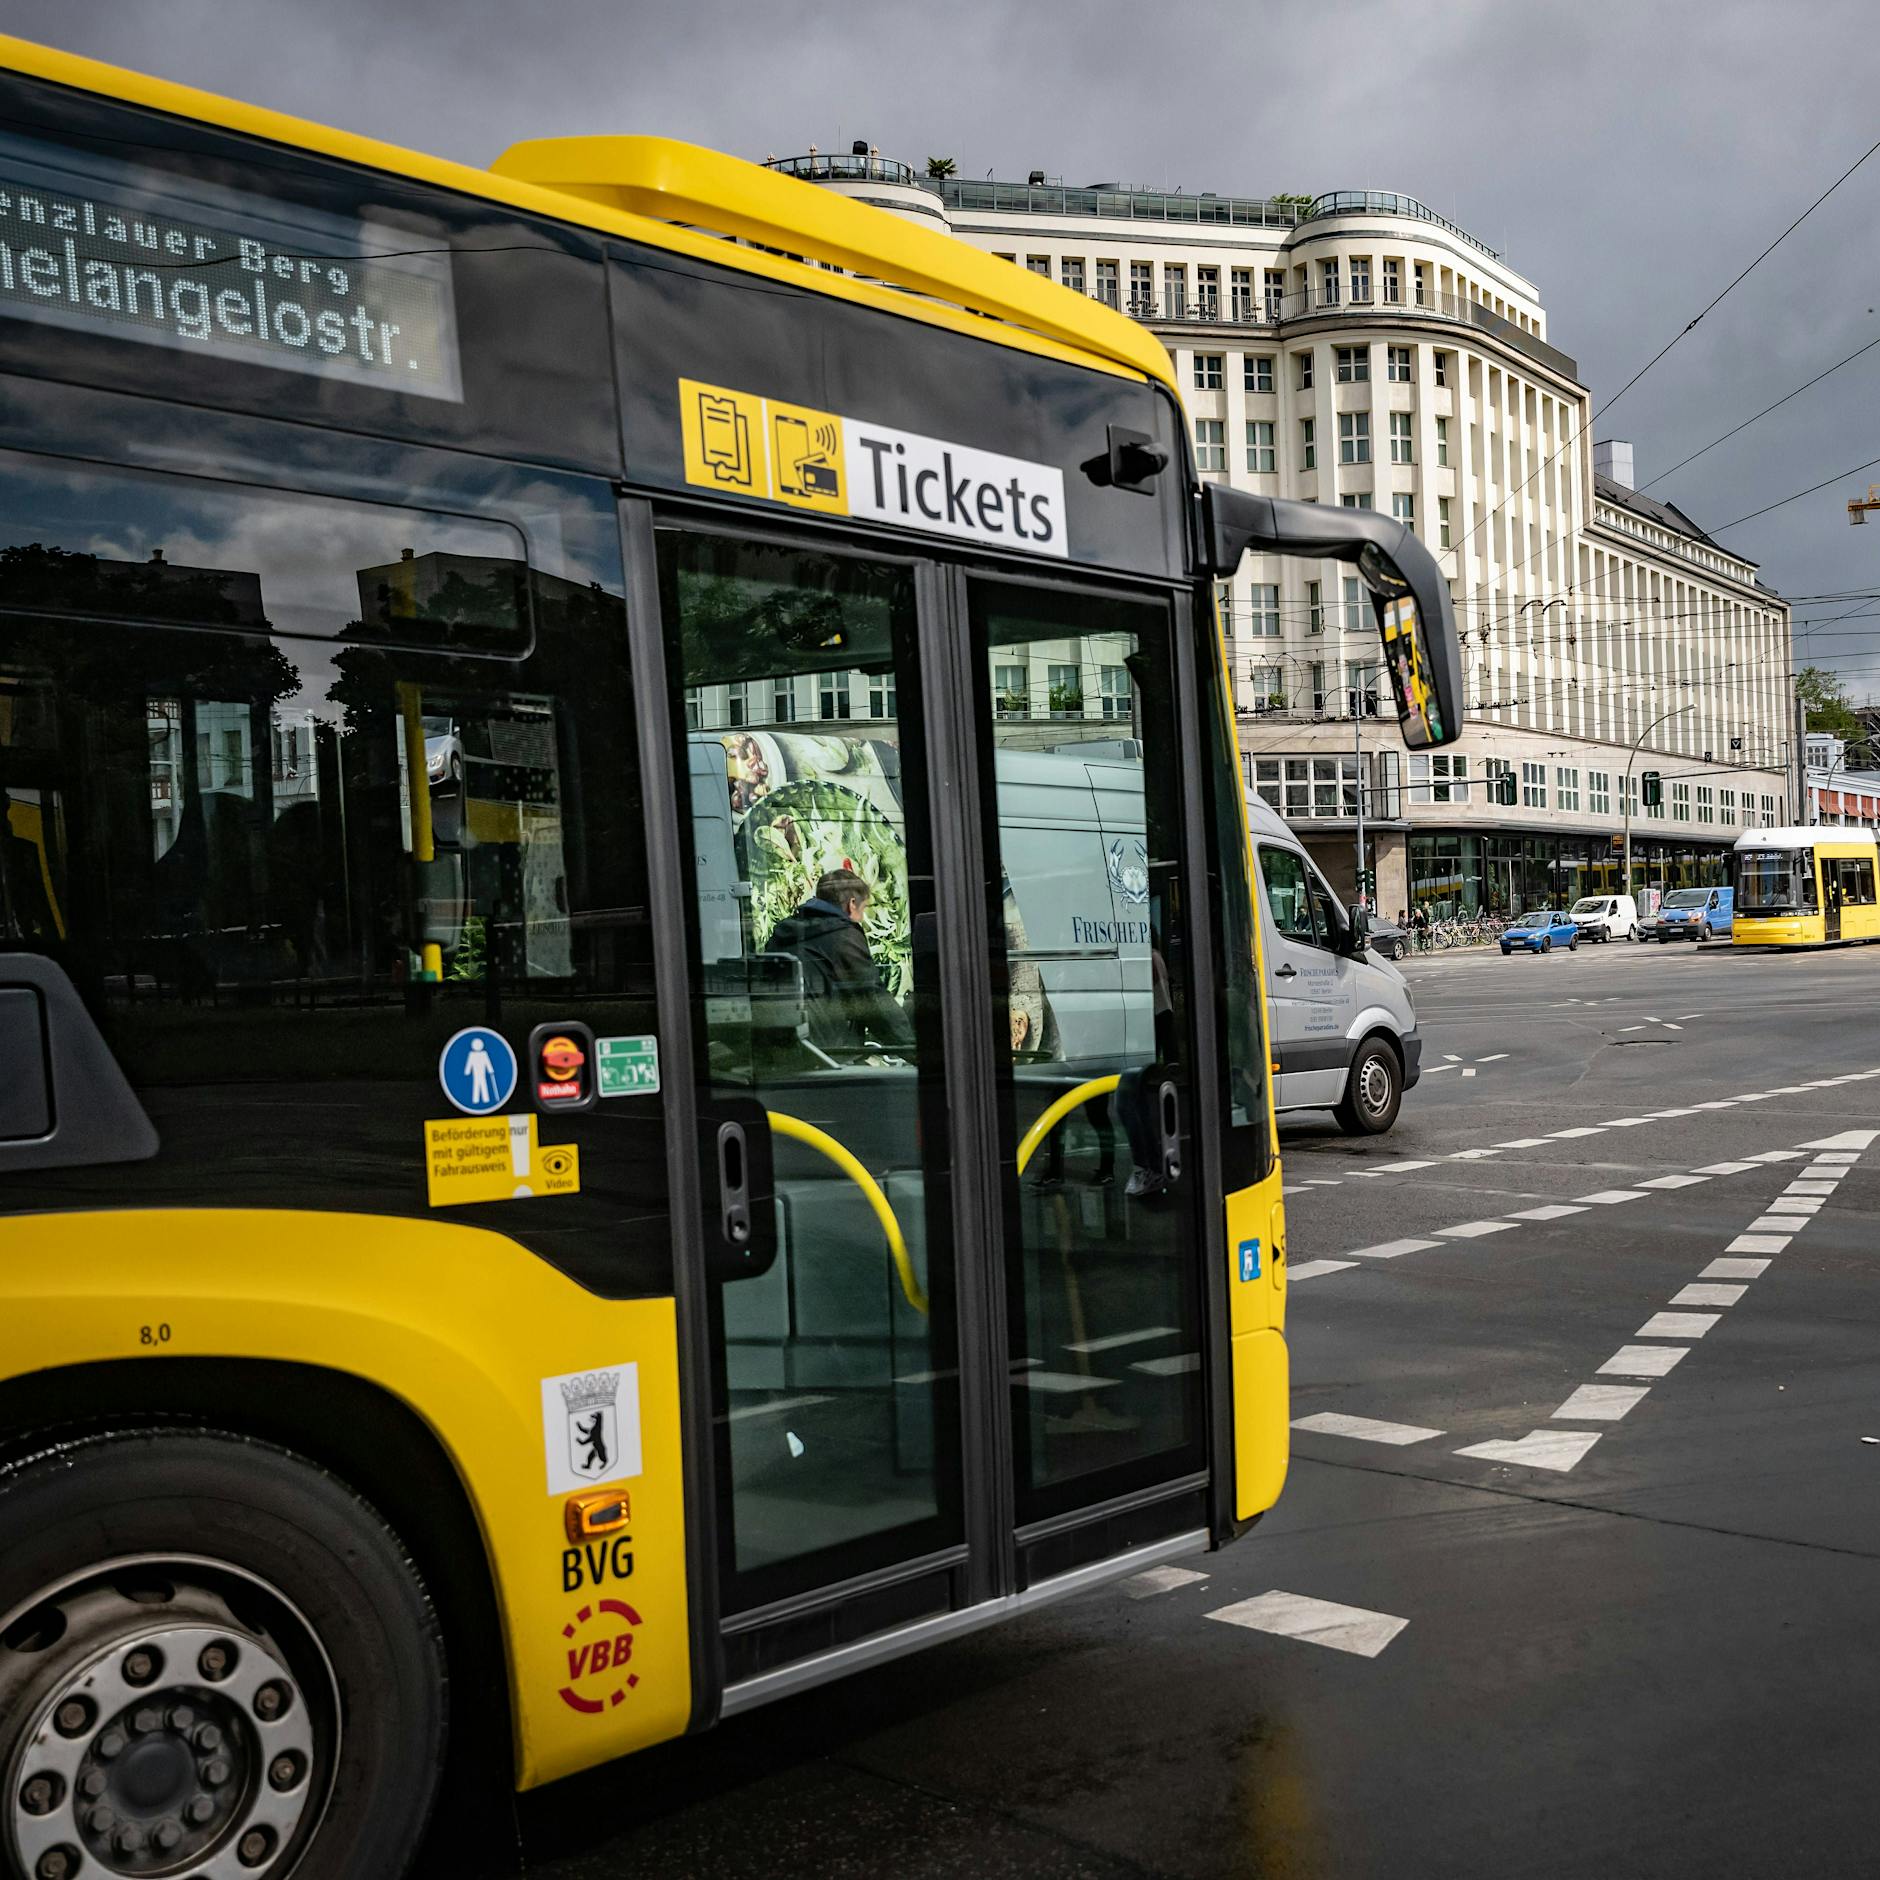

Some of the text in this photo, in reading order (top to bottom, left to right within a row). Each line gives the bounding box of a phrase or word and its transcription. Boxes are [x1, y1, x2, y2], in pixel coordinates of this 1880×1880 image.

[238, 237, 350, 295] Berg
[859, 436, 1053, 543] Tickets
[1071, 916, 1151, 944] FRISCHEP
[432, 1124, 529, 1143] Beförderung nur
[433, 1144, 510, 1161] mit gültigem
[433, 1160, 507, 1178] Fahrausweis
[545, 1179, 574, 1190] Video
[140, 1323, 171, 1347] 8,0
[562, 1535, 634, 1593] BVG
[567, 1632, 634, 1681] VBB
